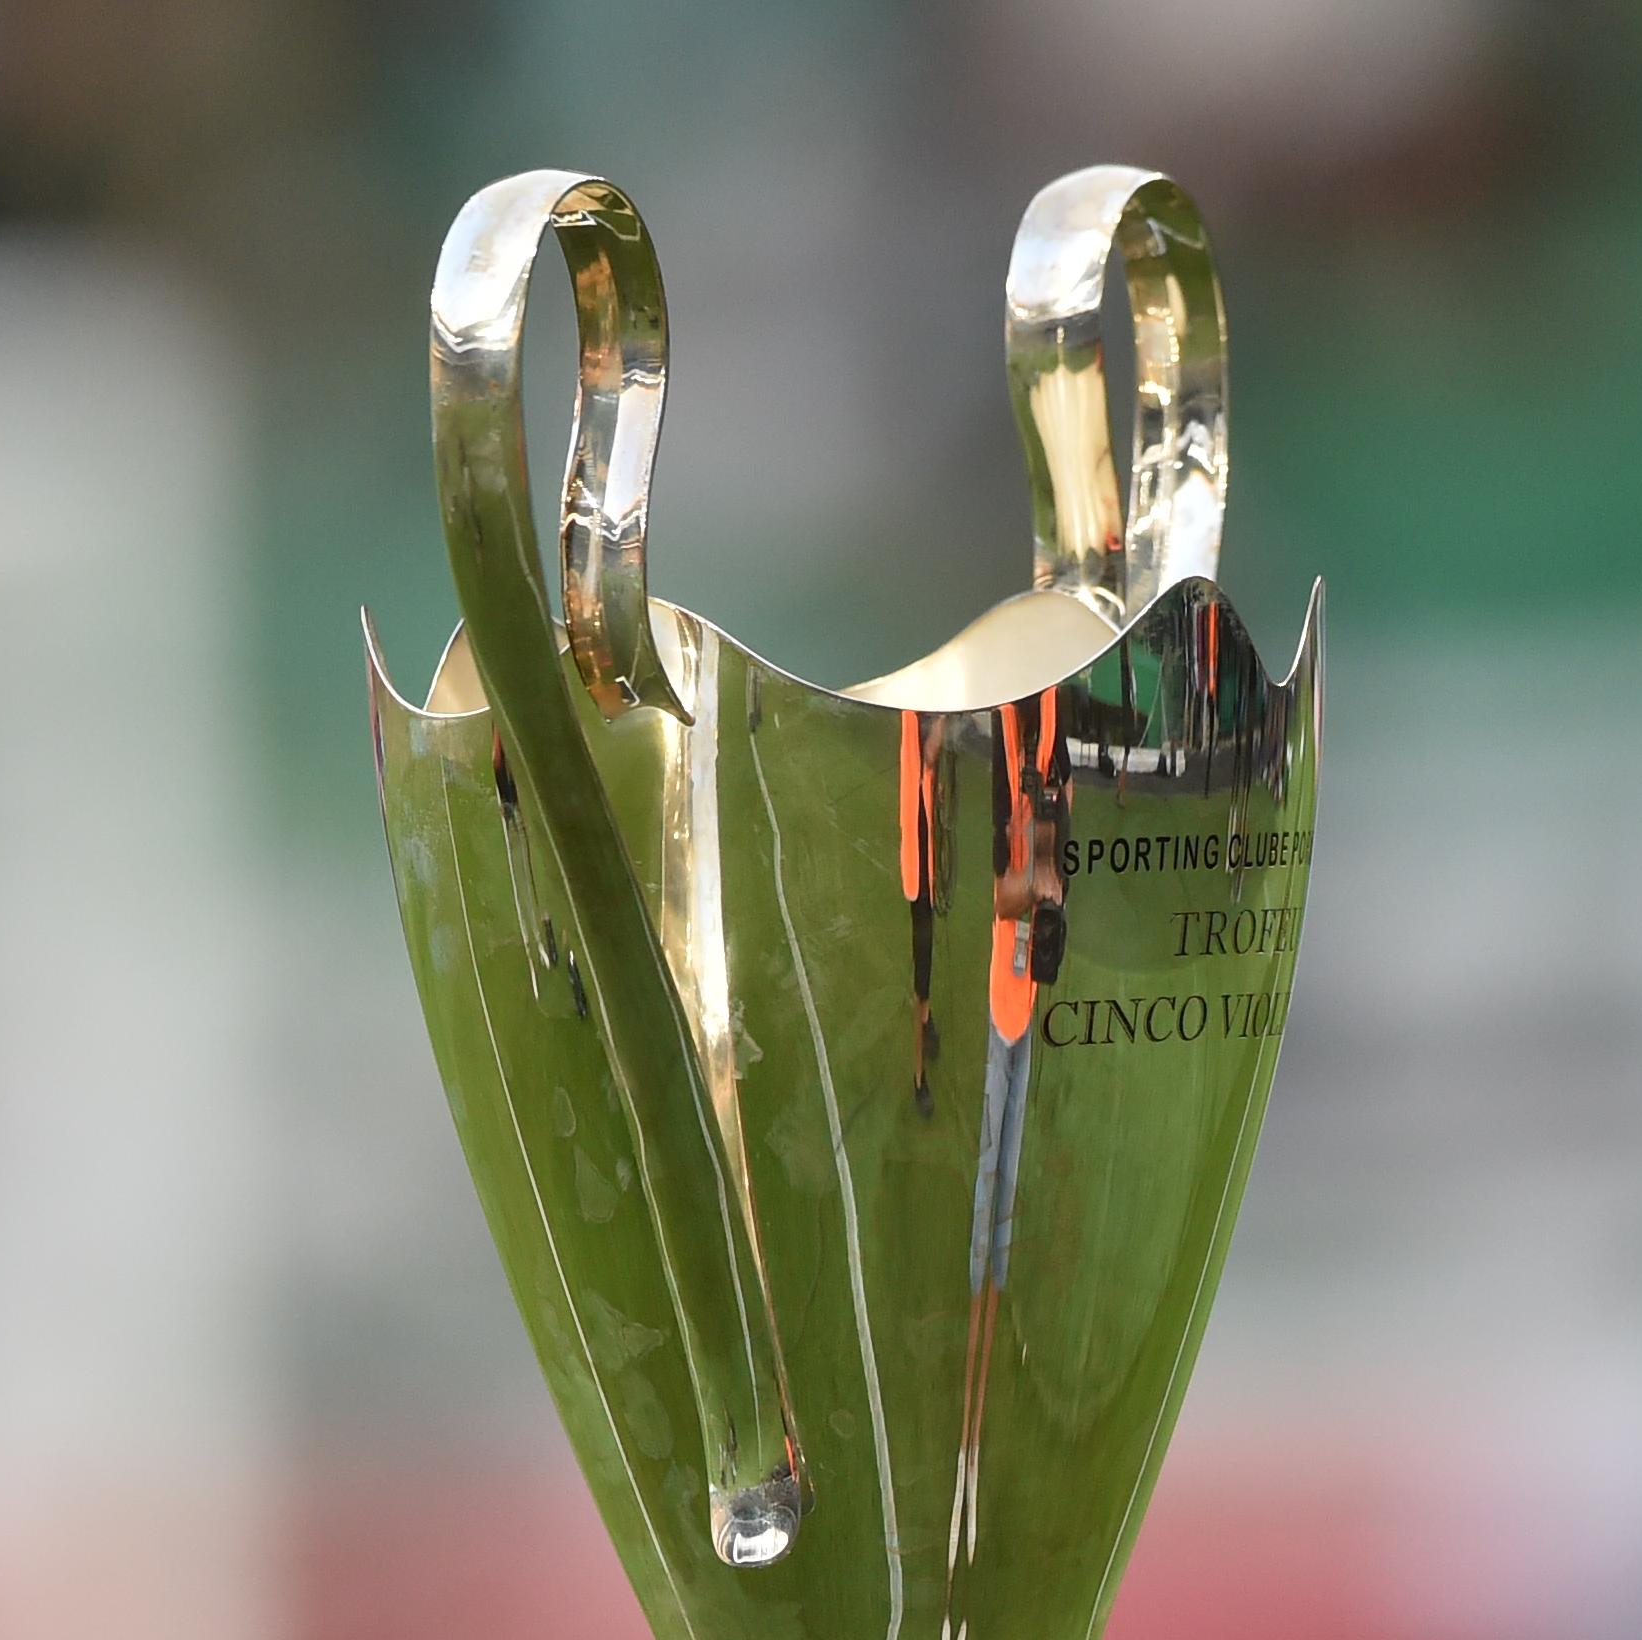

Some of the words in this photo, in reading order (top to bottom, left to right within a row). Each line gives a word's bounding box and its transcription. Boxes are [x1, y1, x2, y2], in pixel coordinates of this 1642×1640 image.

[1063, 834, 1219, 876] SPORTING
[1227, 831, 1289, 867] CLUBE
[1042, 995, 1208, 1047] CINCO
